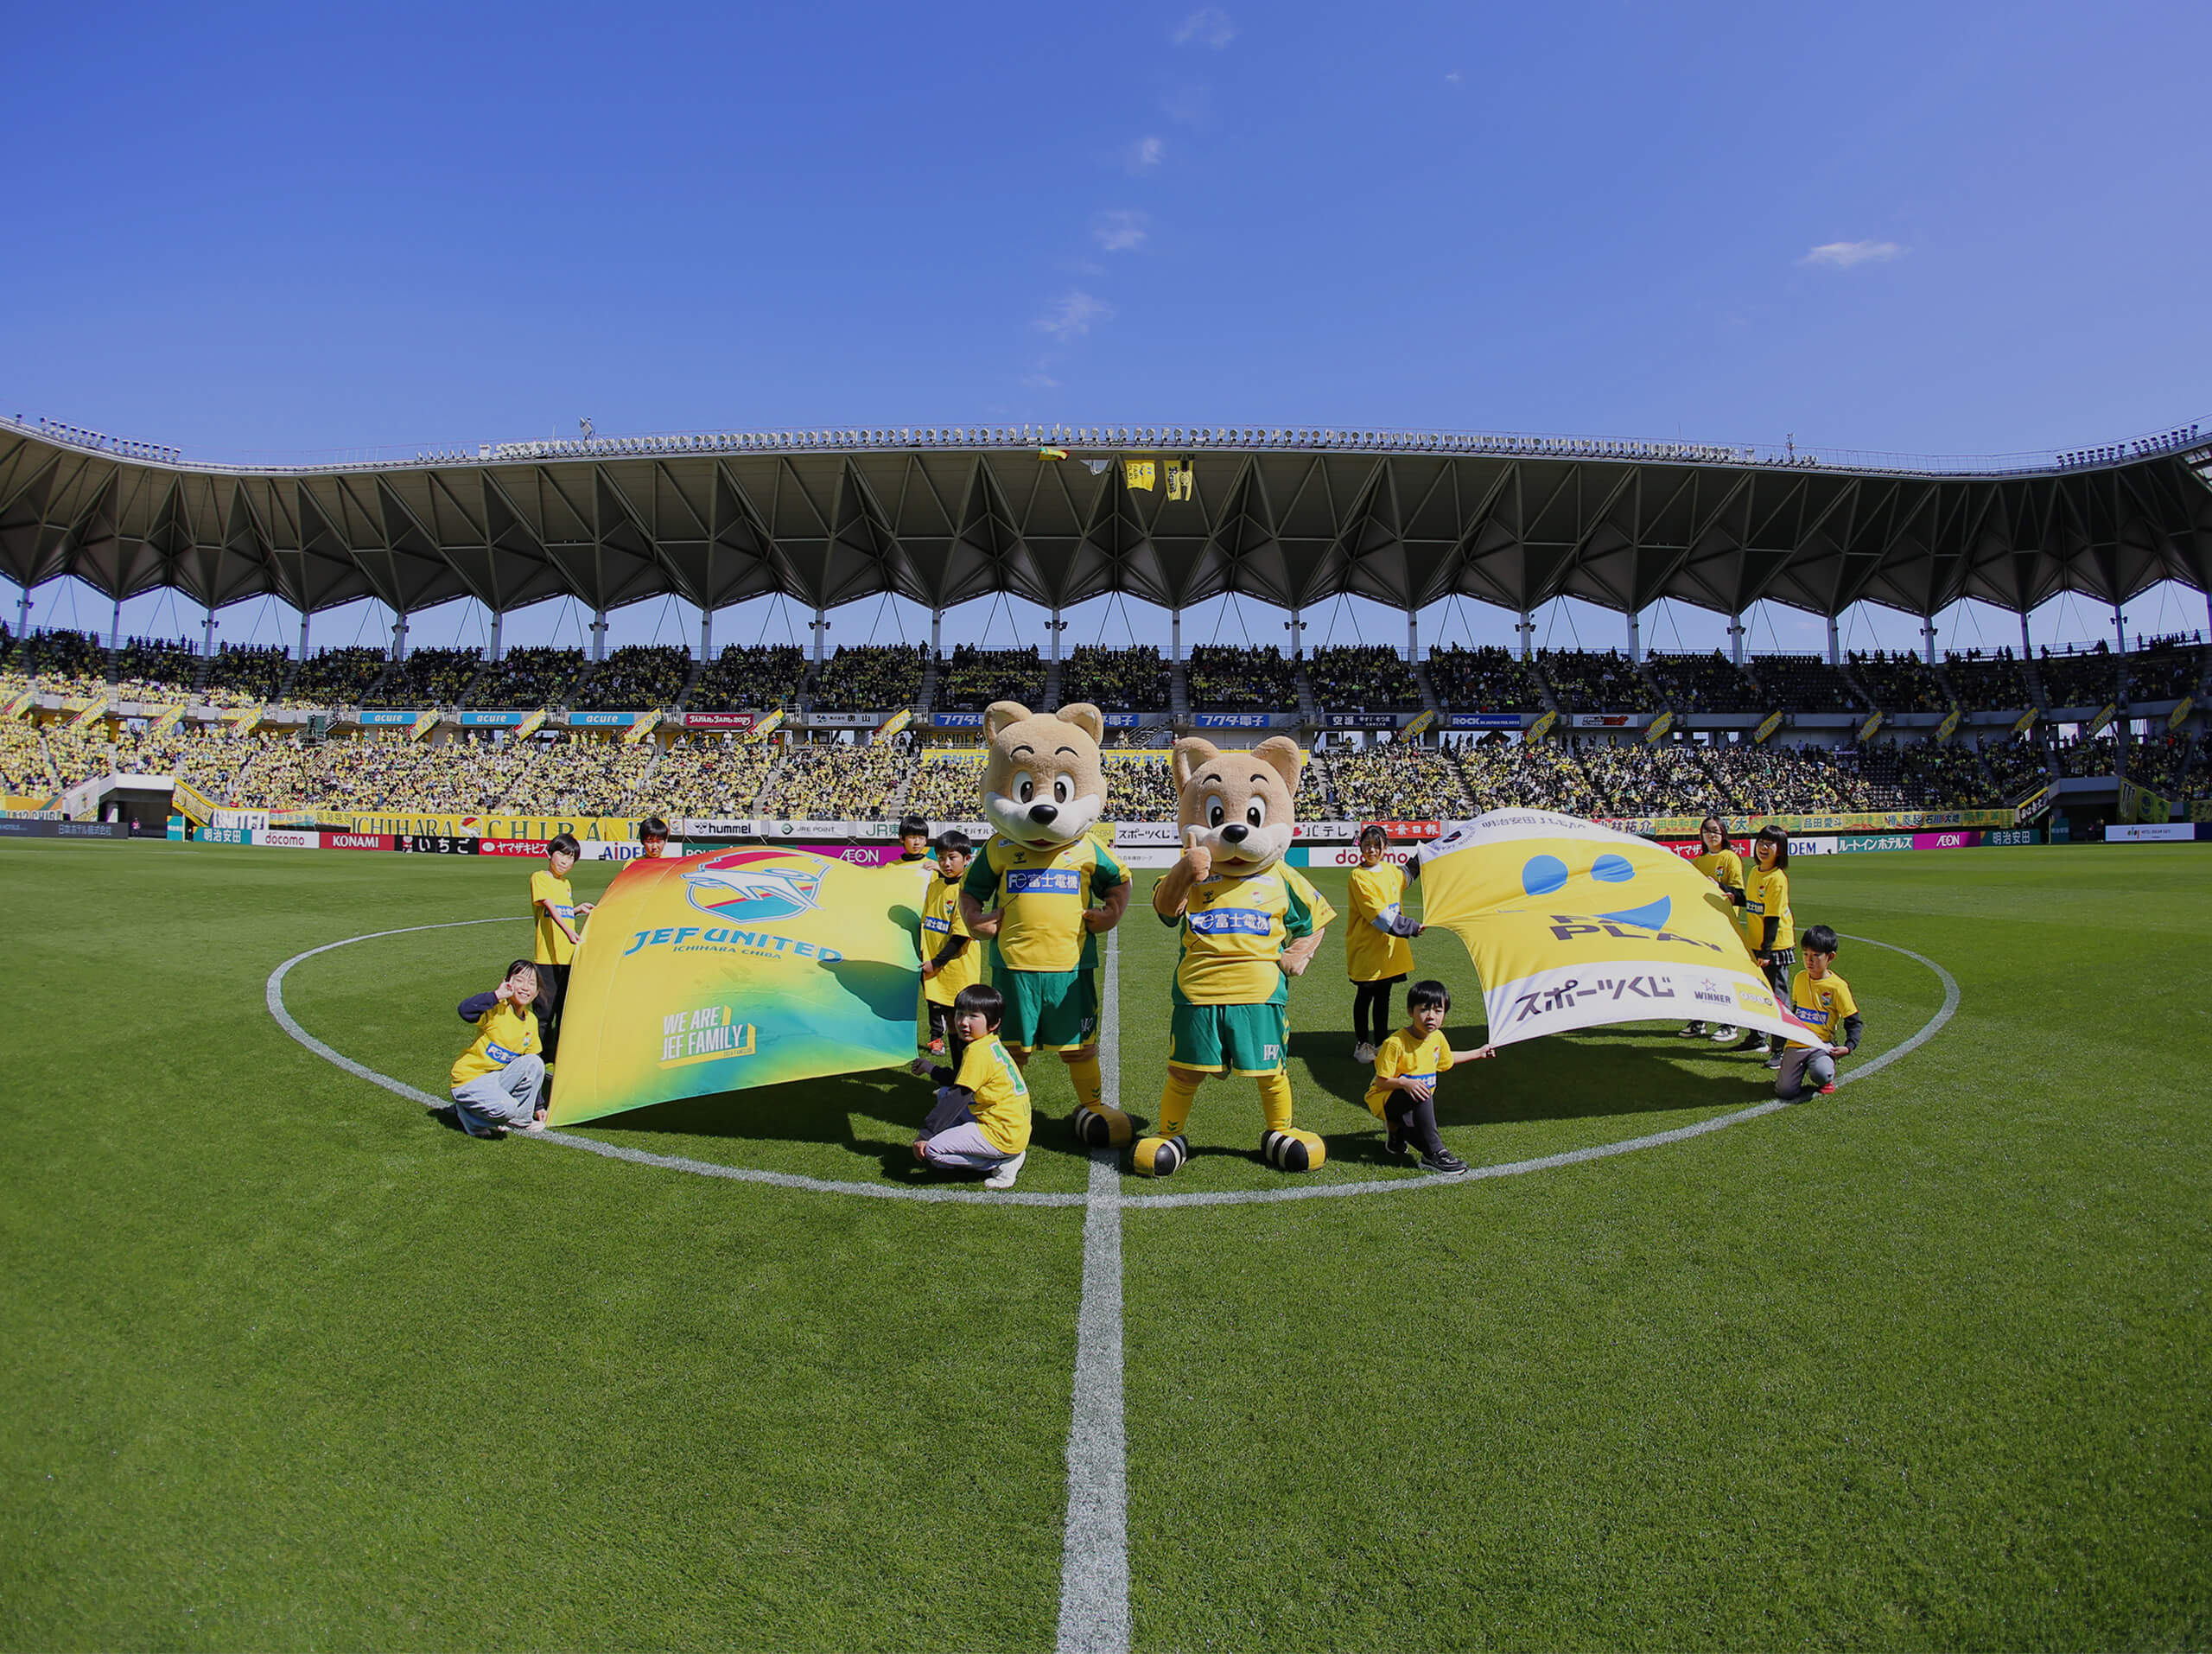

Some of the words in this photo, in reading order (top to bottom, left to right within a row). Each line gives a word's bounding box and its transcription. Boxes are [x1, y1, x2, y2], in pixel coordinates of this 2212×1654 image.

[586, 715, 619, 723] acure
[940, 715, 984, 725] フクダ
[1202, 716, 1264, 725] フクダ電子
[203, 828, 242, 843] 明治安田
[351, 816, 454, 837] ICHIHARA
[487, 820, 601, 842] CHIBA
[709, 823, 752, 835] hummel
[1118, 828, 1170, 839] スポーツくじ
[265, 832, 305, 846] docomo
[332, 835, 379, 848] KONAMI
[1839, 837, 1913, 852] ルートインホテルズ
[1992, 830, 2031, 845] 明治安田
[419, 837, 470, 854] いちご
[1789, 842, 1816, 855] DEM
[1028, 873, 1078, 889] 富士電機
[1215, 913, 1269, 931] 富士電機
[623, 926, 701, 957] JEF
[703, 927, 843, 964] UNITED
[741, 949, 782, 960] CHIBA
[1515, 976, 1675, 1022] スポーツくじ
[1694, 990, 1732, 1004] WINNER
[663, 1011, 689, 1035] WE
[690, 1006, 721, 1030] ARE
[660, 1034, 685, 1060] JEF
[688, 1023, 743, 1056] FAMILY
